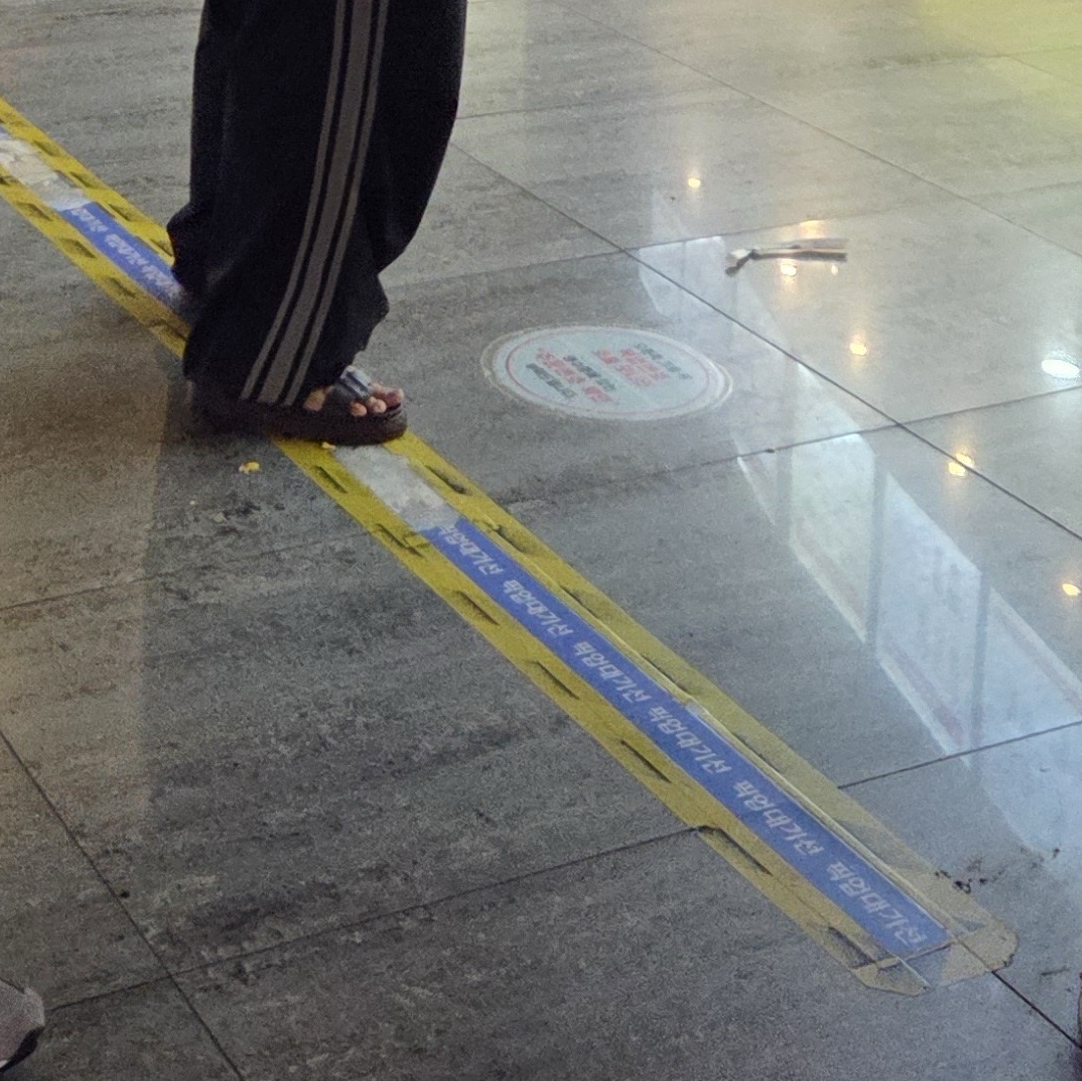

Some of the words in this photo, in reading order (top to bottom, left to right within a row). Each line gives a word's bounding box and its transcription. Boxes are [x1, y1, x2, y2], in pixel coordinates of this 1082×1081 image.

[502, 578, 574, 636] 픽업대기선
[572, 640, 653, 704] 픽업대기선
[647, 704, 733, 775] 픽업대기선
[732, 778, 825, 856] 픽업대기선
[825, 860, 927, 946] 픽업대기선
